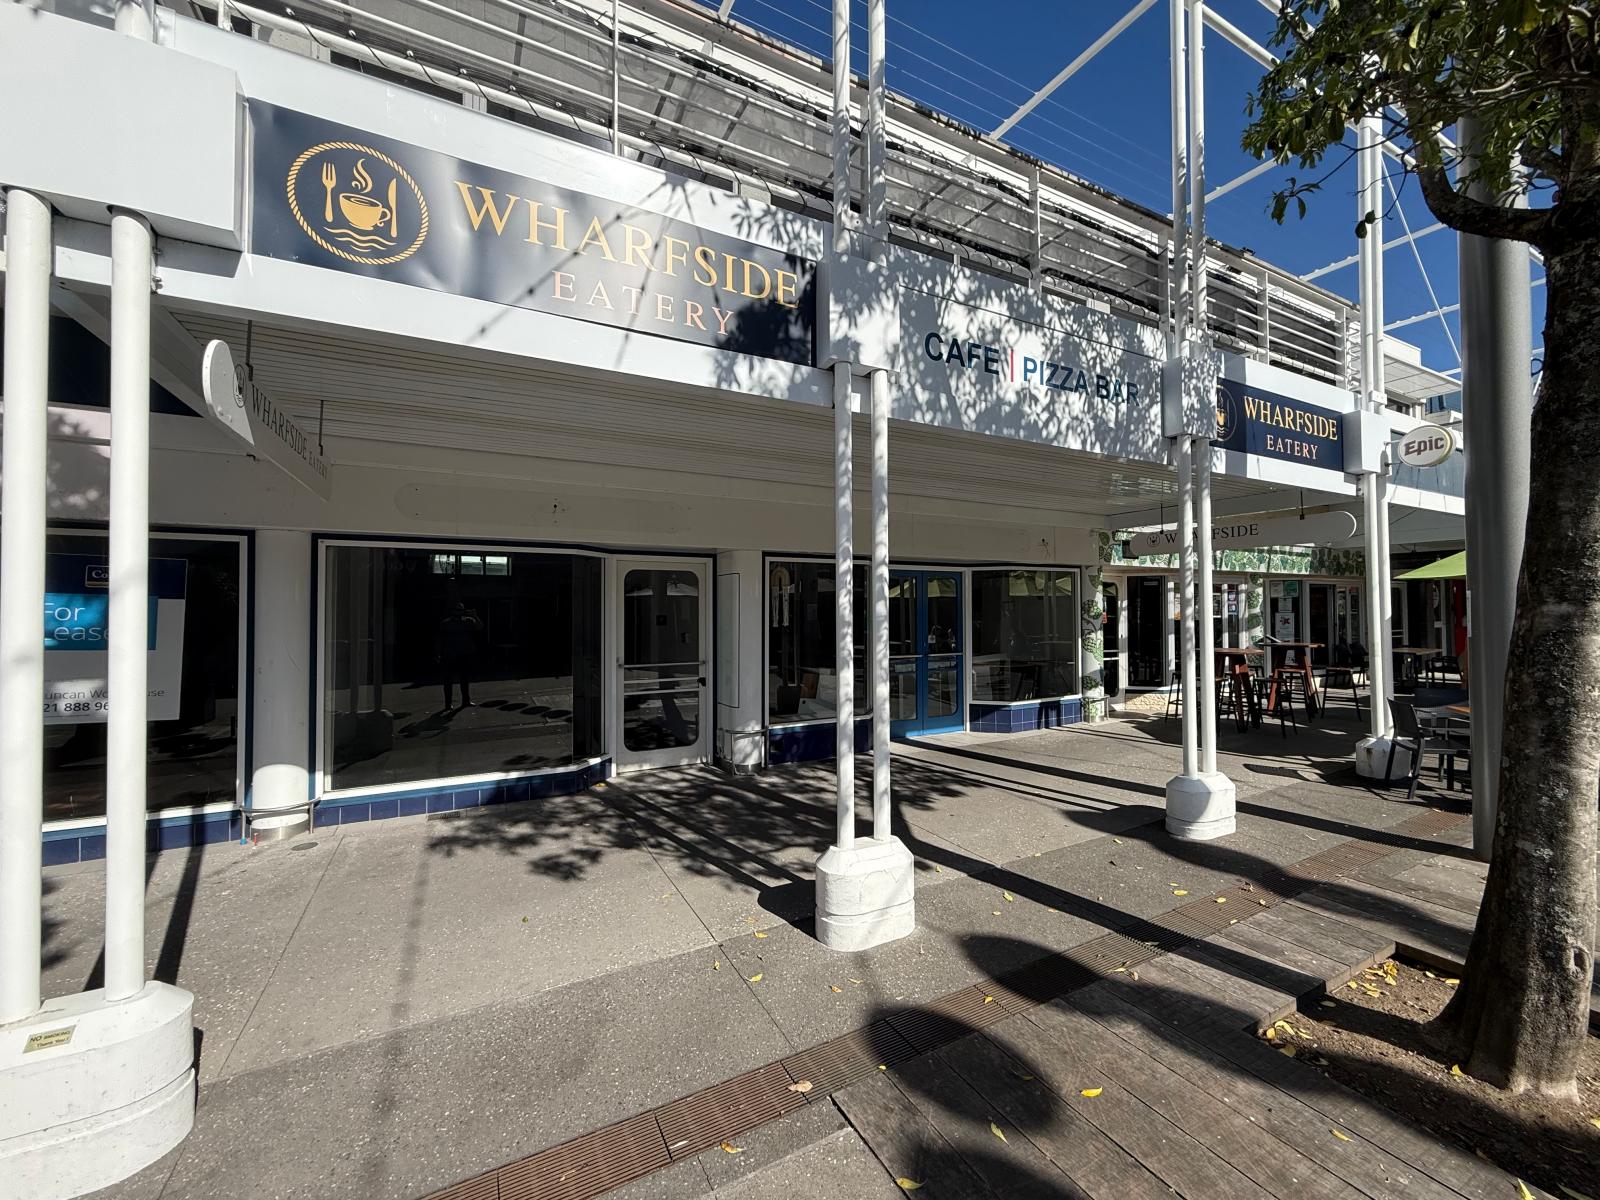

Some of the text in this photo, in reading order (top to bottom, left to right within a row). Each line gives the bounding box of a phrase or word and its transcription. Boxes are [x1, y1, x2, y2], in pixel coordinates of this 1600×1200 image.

[455, 181, 799, 308] WHARFSIDE
[551, 270, 735, 335] EATERY
[924, 332, 1139, 406] CAFE PIZZA BAR
[252, 384, 328, 480] WHARFSIDE EATERY
[1244, 396, 1338, 441] WHARFSIDE
[1266, 434, 1318, 460] EATERY
[1404, 436, 1445, 456] Epic
[1165, 523, 1259, 544] WAFSIDE
[43, 703, 58, 713] 21
[64, 702, 90, 712] 888
[44, 689, 85, 700] uncan
